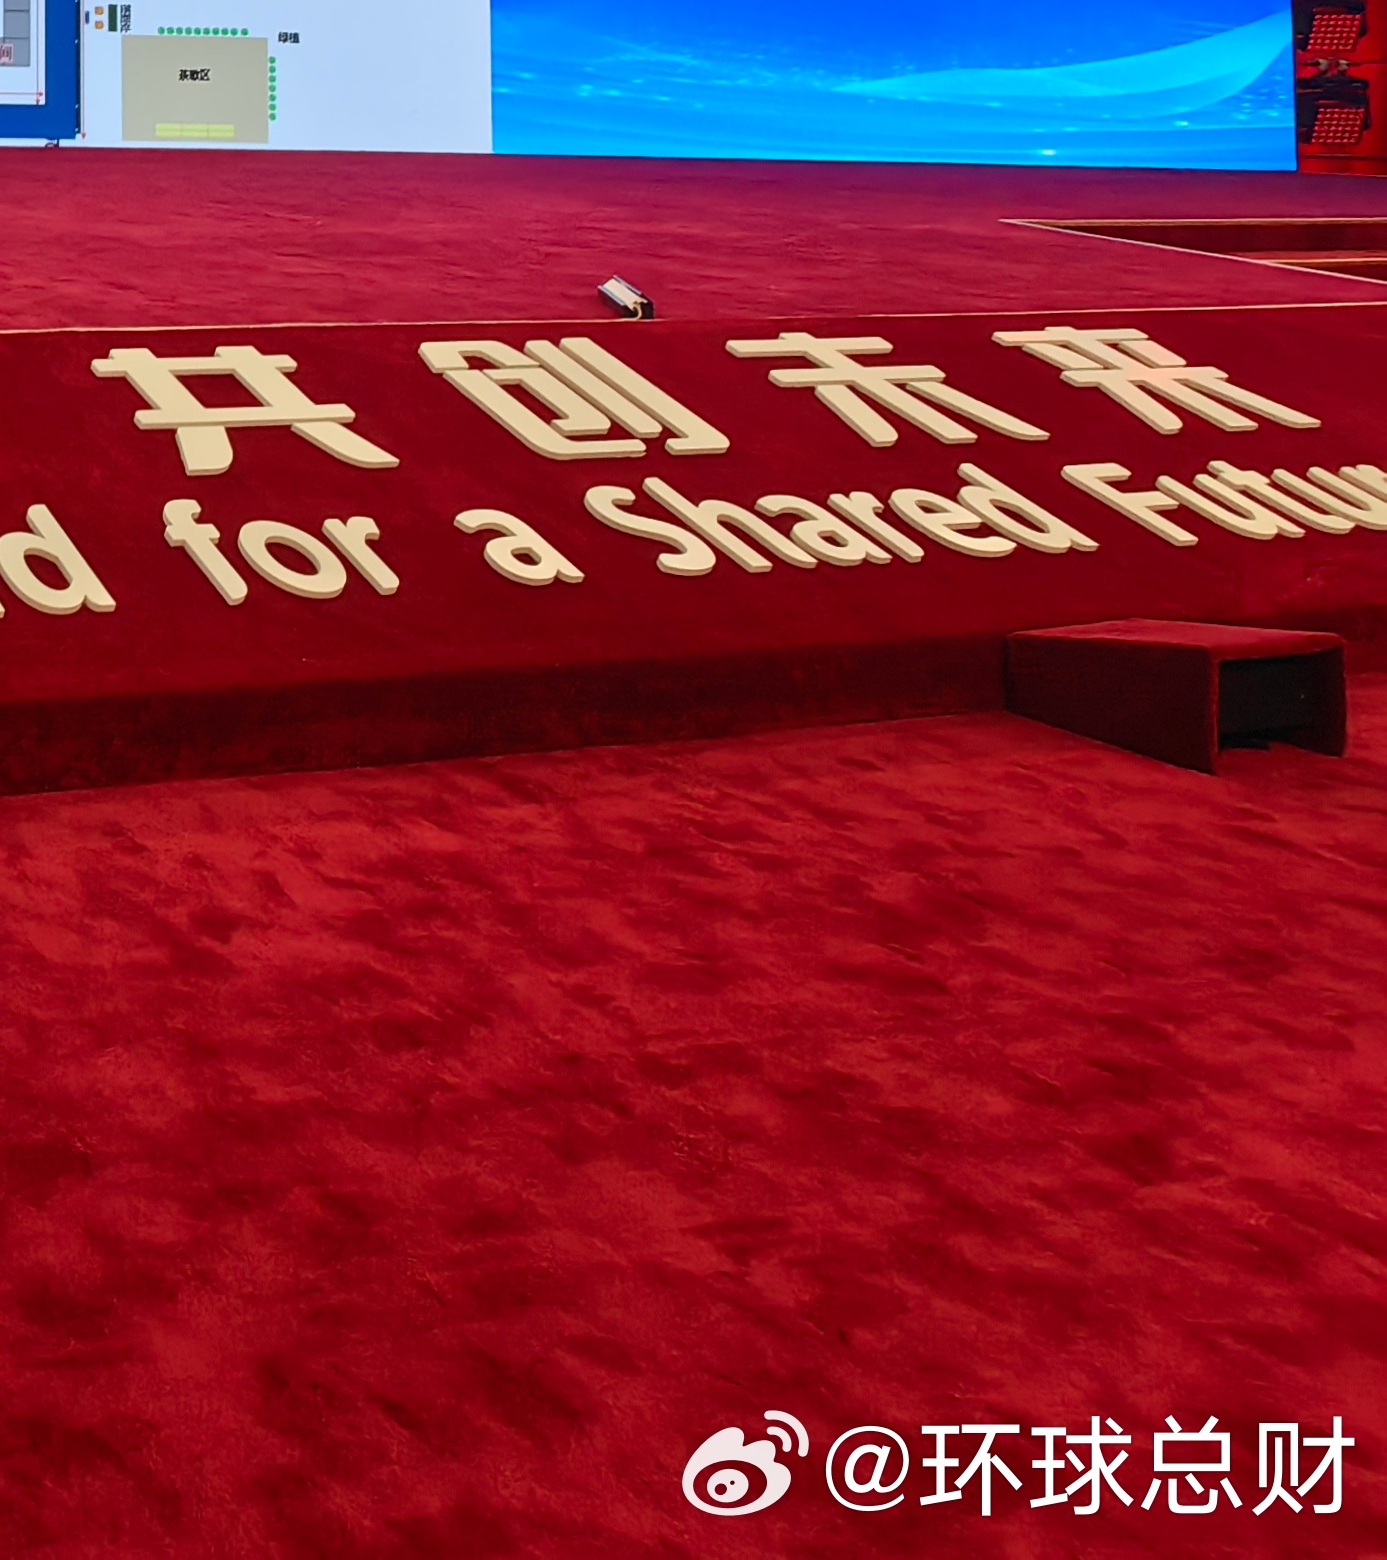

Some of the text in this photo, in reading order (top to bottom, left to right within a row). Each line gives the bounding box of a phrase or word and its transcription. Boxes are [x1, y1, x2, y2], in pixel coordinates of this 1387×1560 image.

[92, 325, 1322, 476] 共创未来
[163, 498, 400, 607] for
[453, 507, 585, 586] a
[584, 463, 1100, 576] Shared
